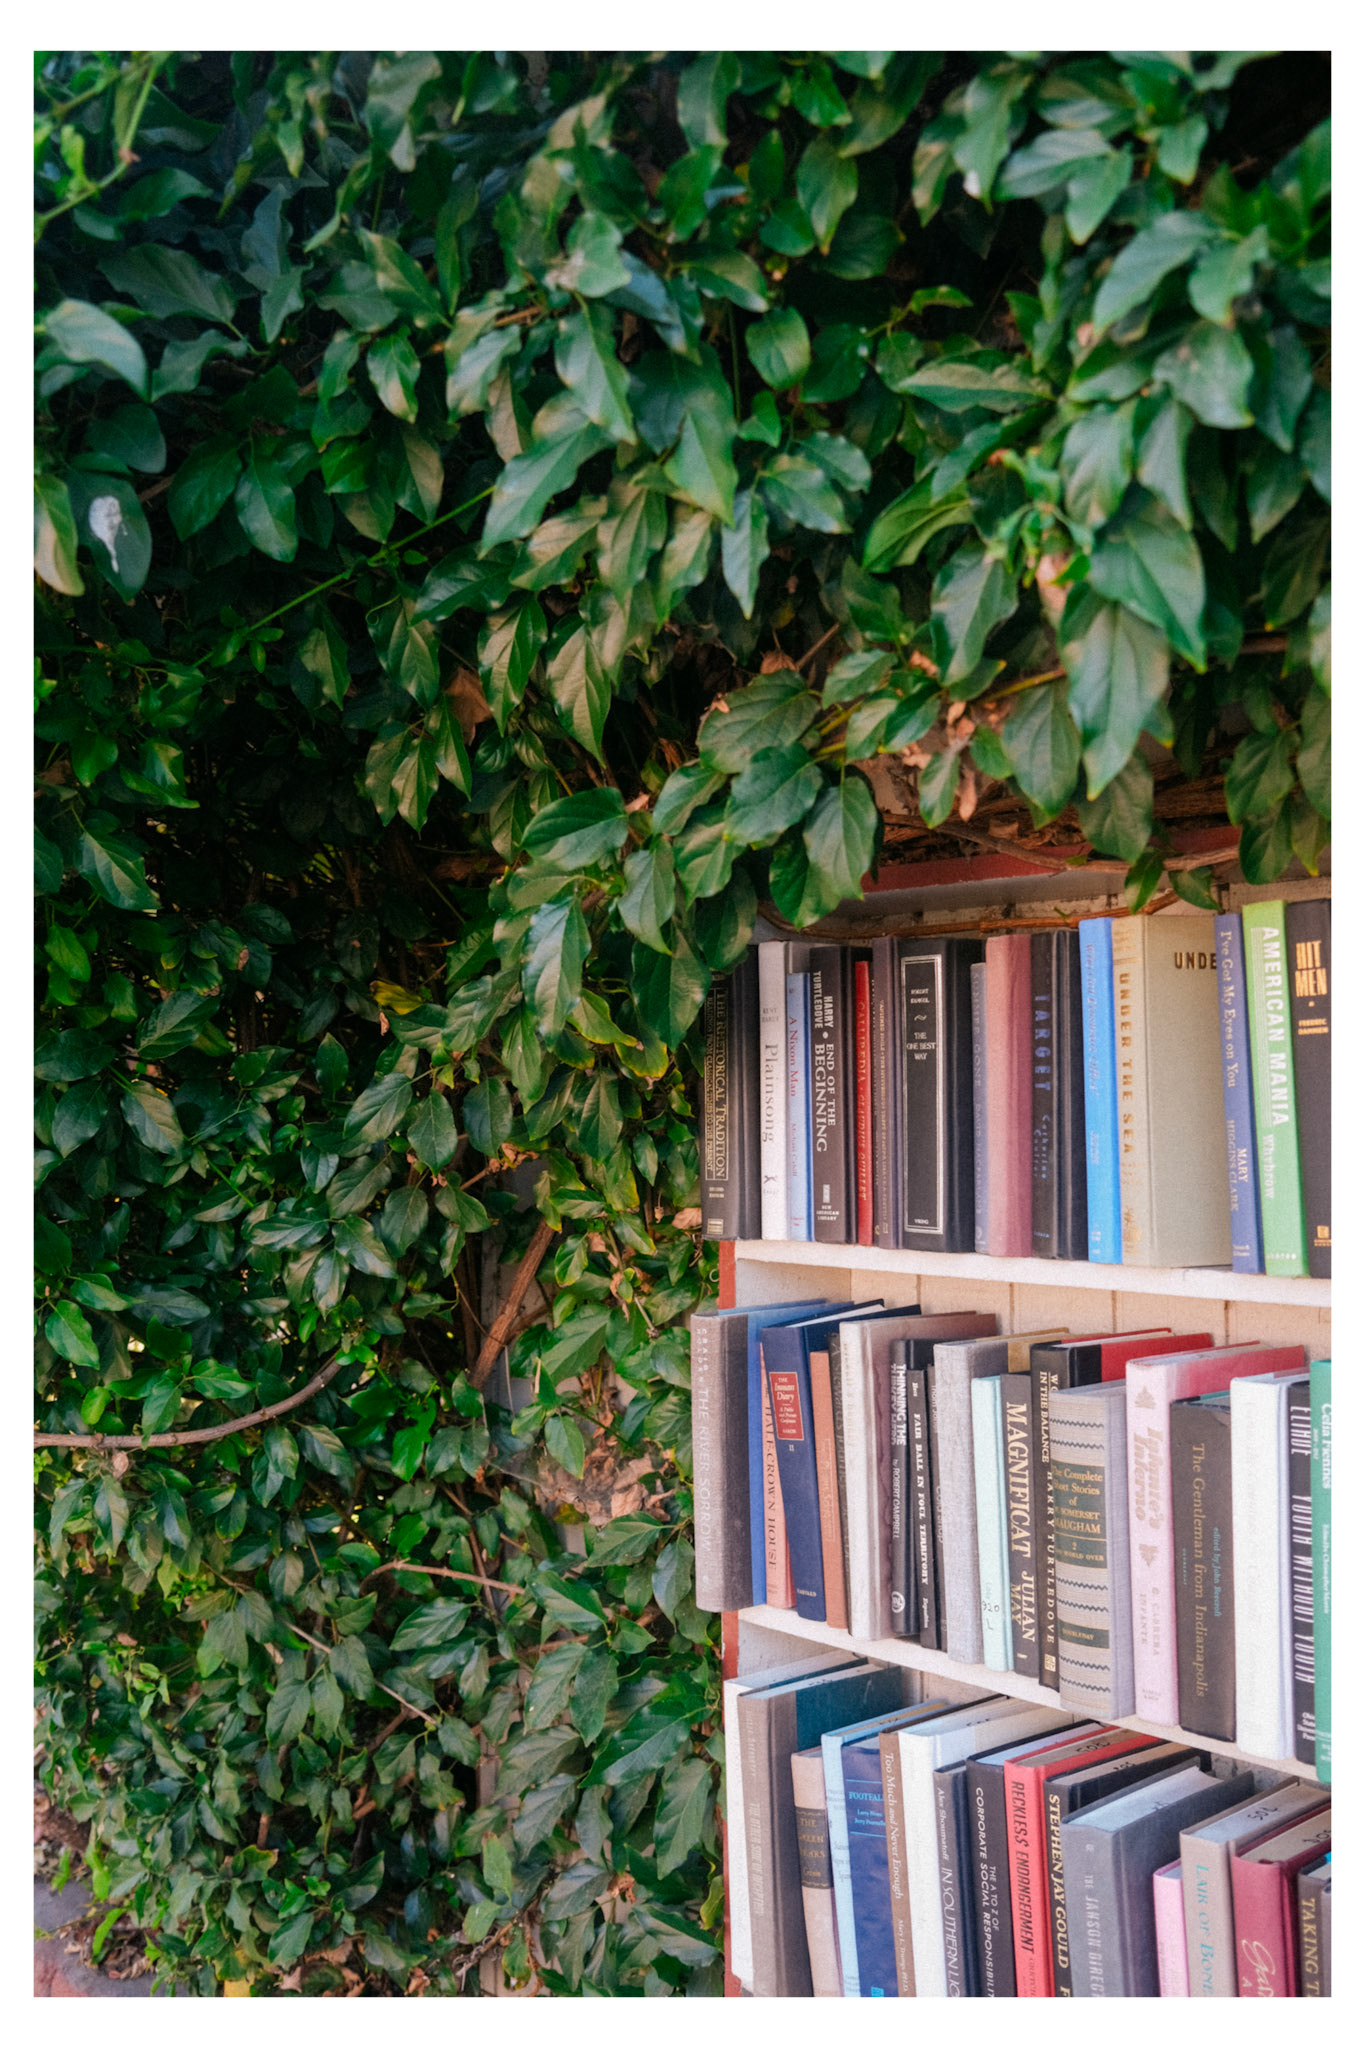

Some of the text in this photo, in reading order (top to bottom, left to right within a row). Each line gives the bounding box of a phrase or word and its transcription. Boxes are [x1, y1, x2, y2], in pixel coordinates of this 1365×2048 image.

[1222, 958, 1233, 981] Got
[1296, 941, 1321, 970] HIT
[717, 993, 728, 1018] THE
[812, 970, 824, 1029] TURTLEDOVE
[1222, 985, 1234, 1006] My
[1295, 968, 1327, 997] MEN
[823, 996, 834, 1028] HARRY
[914, 1032, 927, 1041] THE
[1225, 1009, 1237, 1041] Eyes
[1262, 927, 1289, 1126] AMERICAN MANIA
[715, 1021, 728, 1101] RHETORICAL
[789, 1016, 799, 1098] A Nixon Man
[914, 1052, 928, 1060] WAY
[920, 1042, 936, 1051] BEST
[1034, 994, 1051, 1092] TARGET
[1119, 972, 1135, 1155] UNDER THE SEA
[1227, 1044, 1237, 1059] on
[763, 1043, 779, 1143] Plainsong
[814, 1044, 827, 1152] BEGINNING
[825, 1044, 836, 1126] END OF THE
[1227, 1063, 1240, 1088] You
[706, 1140, 714, 1171] PRESENT
[716, 1104, 728, 1178] TRADITION
[1237, 1148, 1248, 1182] MARY
[1262, 1134, 1276, 1199] Whybrow
[776, 1391, 794, 1403] Diary
[896, 1363, 907, 1446] THINNING THE
[1041, 1372, 1050, 1463] IN THE BALANCE
[697, 1388, 712, 1552] THE RIVER SORROW
[892, 1467, 900, 1498] ROBERT
[1006, 1402, 1031, 1557] MAGNIFICAT
[1064, 1467, 1103, 1483] Complete
[1071, 1483, 1100, 1496] Stories
[1134, 1432, 1150, 1521] Inferno
[1147, 1427, 1164, 1530] Infante's
[892, 1498, 901, 1540] CAMPBELL
[914, 1413, 929, 1585] FAIR BALL IN FOUL TERRITORY
[1069, 1496, 1078, 1507] of
[767, 1518, 777, 1571] HOUSE
[1046, 1472, 1056, 1644] HARRY TURTLEDOVE
[1085, 1552, 1105, 1562] OVER
[1192, 1443, 1210, 1697] The Gentleman from Indianapolis
[1212, 1527, 1223, 1618] edited by John Beecroft
[1292, 1495, 1315, 1683] YOUTH WITHOUT YOUTH
[1011, 1581, 1022, 1624] MAY
[1021, 1570, 1036, 1643] JULIAN
[937, 1787, 946, 1808] Alex
[800, 1818, 817, 1828] THE
[884, 1752, 904, 1899] Too Much and Never Enough
[975, 1787, 988, 1859] CORPORATE
[942, 1867, 954, 1883] IN
[980, 1862, 991, 1908] SOCIAL
[989, 1865, 997, 1882] THE
[1011, 1781, 1035, 1955] RECKLESS ENDANGERMENT
[1048, 1793, 1069, 1969] STEPHEN JAY GOULD
[991, 1894, 999, 1907] TO
[993, 1917, 1000, 1931] OF
[1085, 1895, 1102, 1948] JANSON
[1198, 1911, 1210, 1937] OF
[943, 1886, 959, 1969] SOUTHERN
[1301, 1897, 1319, 1975] TAKING
[1242, 1976, 1251, 1987] A
